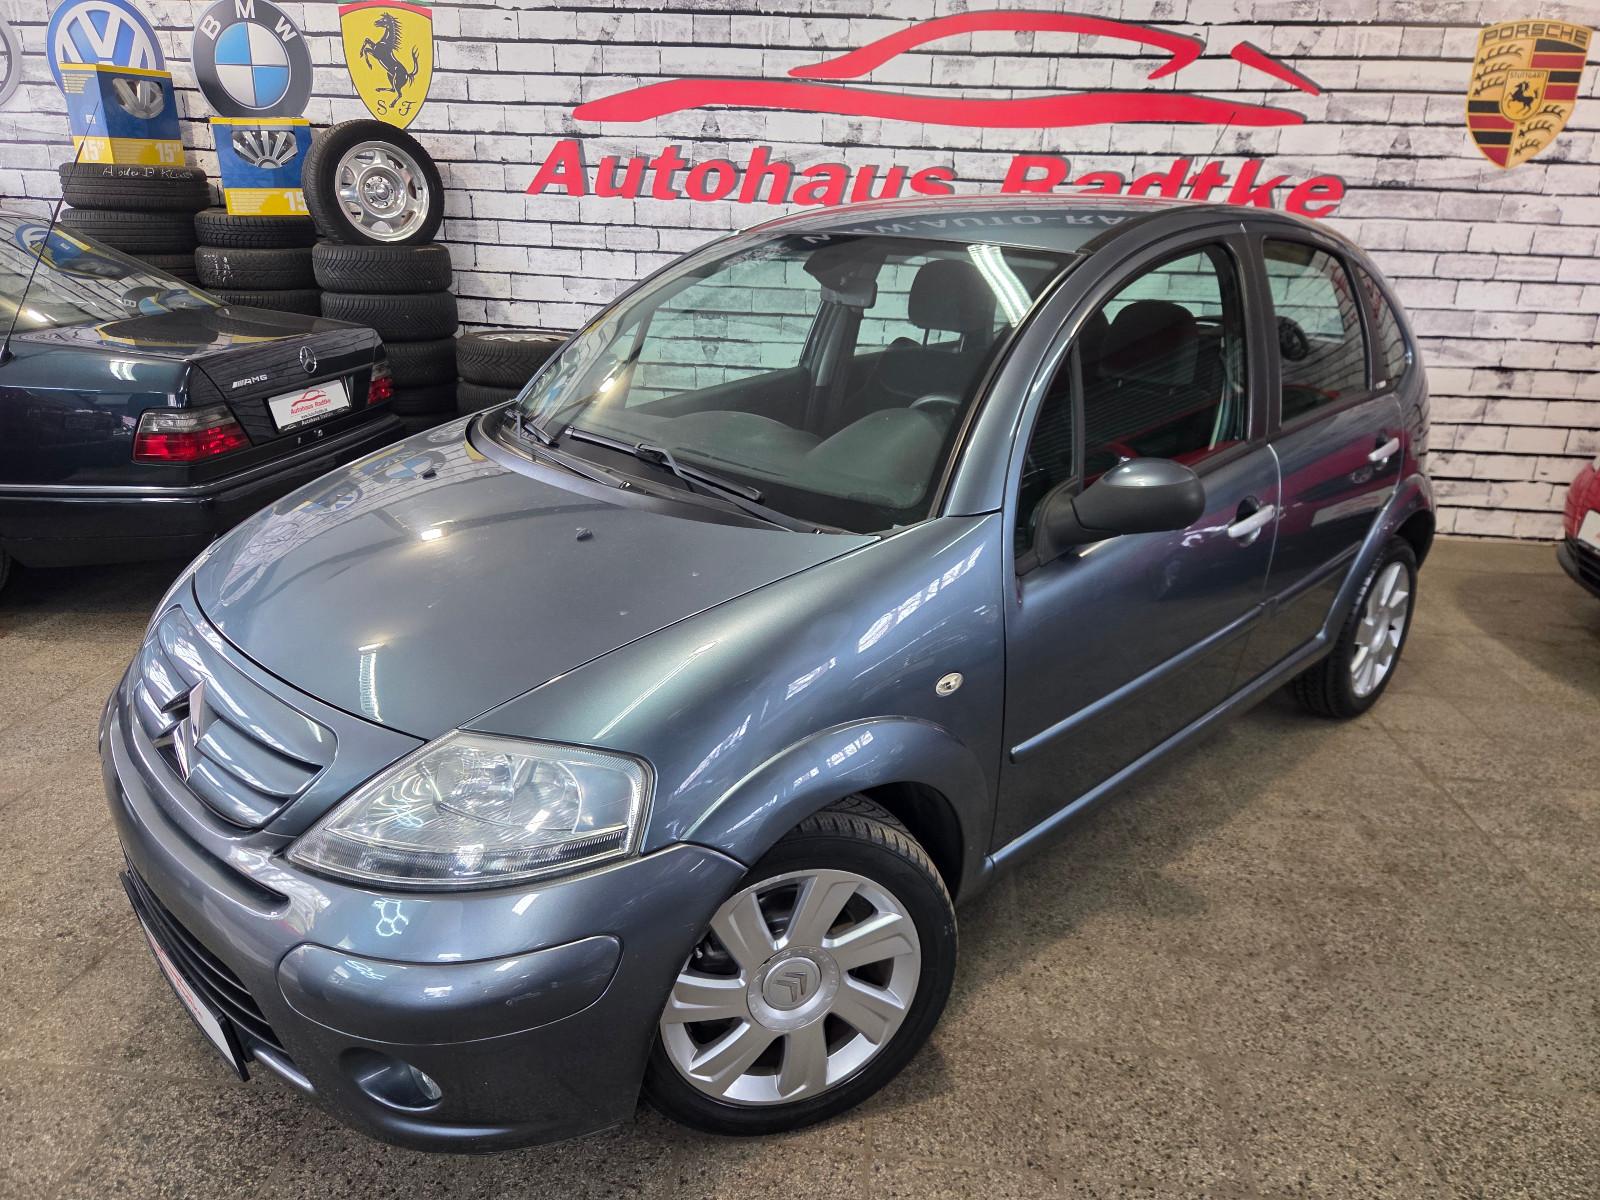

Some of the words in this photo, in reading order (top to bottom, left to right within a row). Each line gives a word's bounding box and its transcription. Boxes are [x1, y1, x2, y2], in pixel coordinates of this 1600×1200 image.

[200, 0, 298, 42] BMW
[1482, 23, 1588, 47] PORSCHE
[526, 138, 957, 207] Autohaus
[1000, 155, 1345, 219] Radtke
